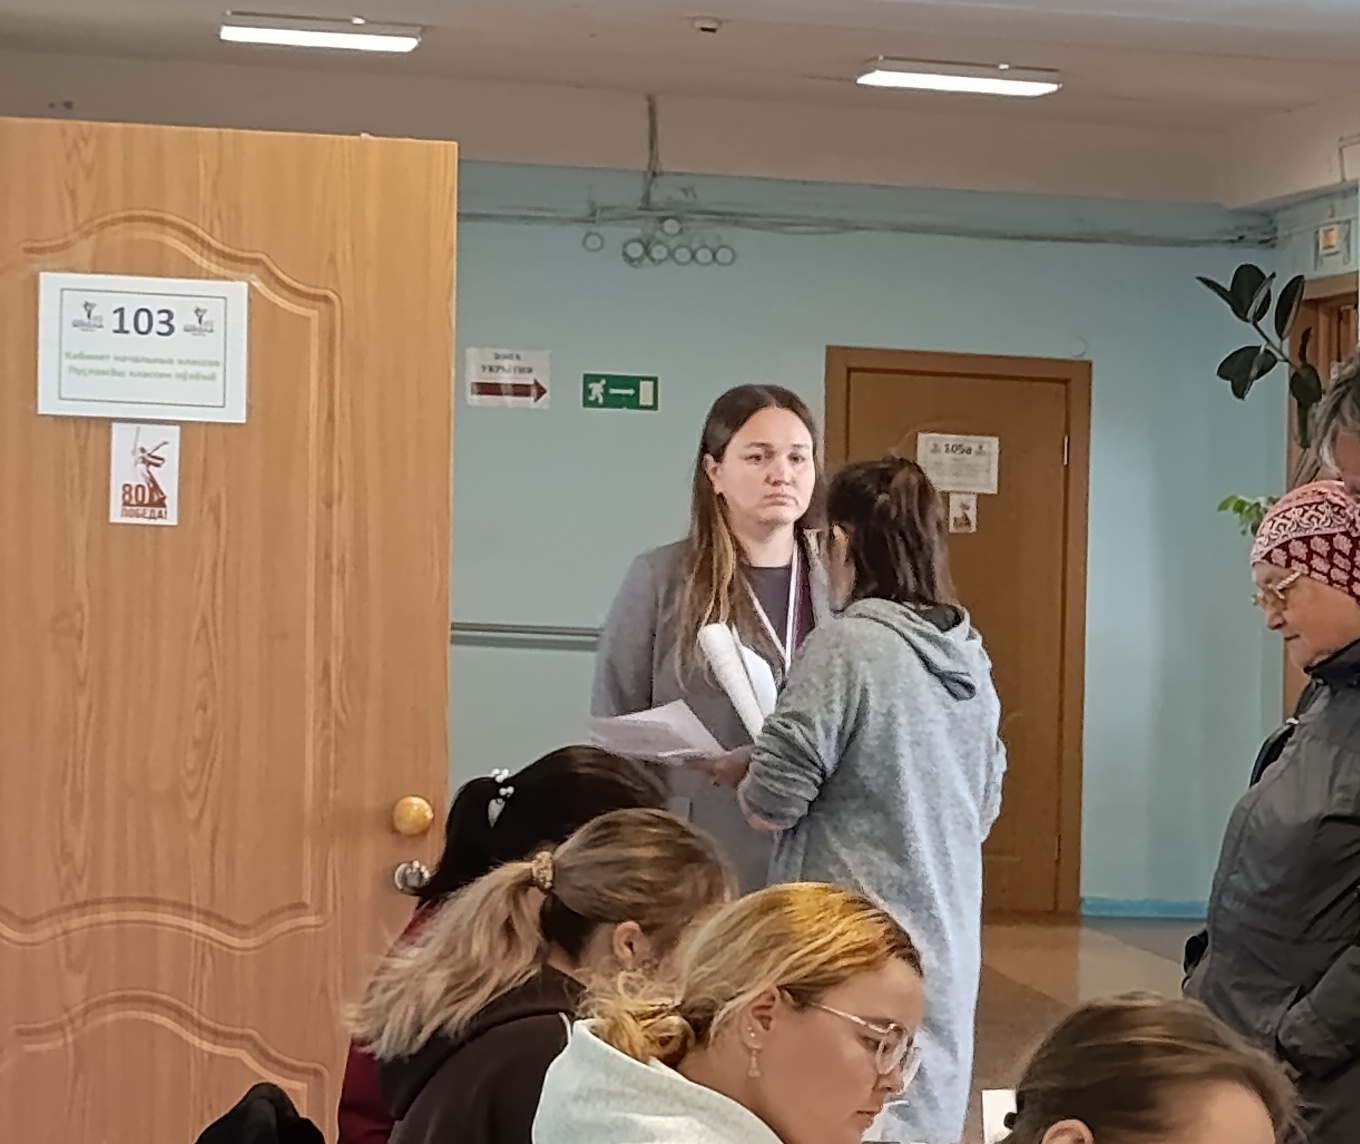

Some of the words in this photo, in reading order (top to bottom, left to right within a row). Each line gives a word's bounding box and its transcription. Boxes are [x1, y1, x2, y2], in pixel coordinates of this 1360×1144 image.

[112, 306, 176, 337] 103
[122, 483, 147, 506] 80
[121, 508, 168, 520] ПОБЕДА!
